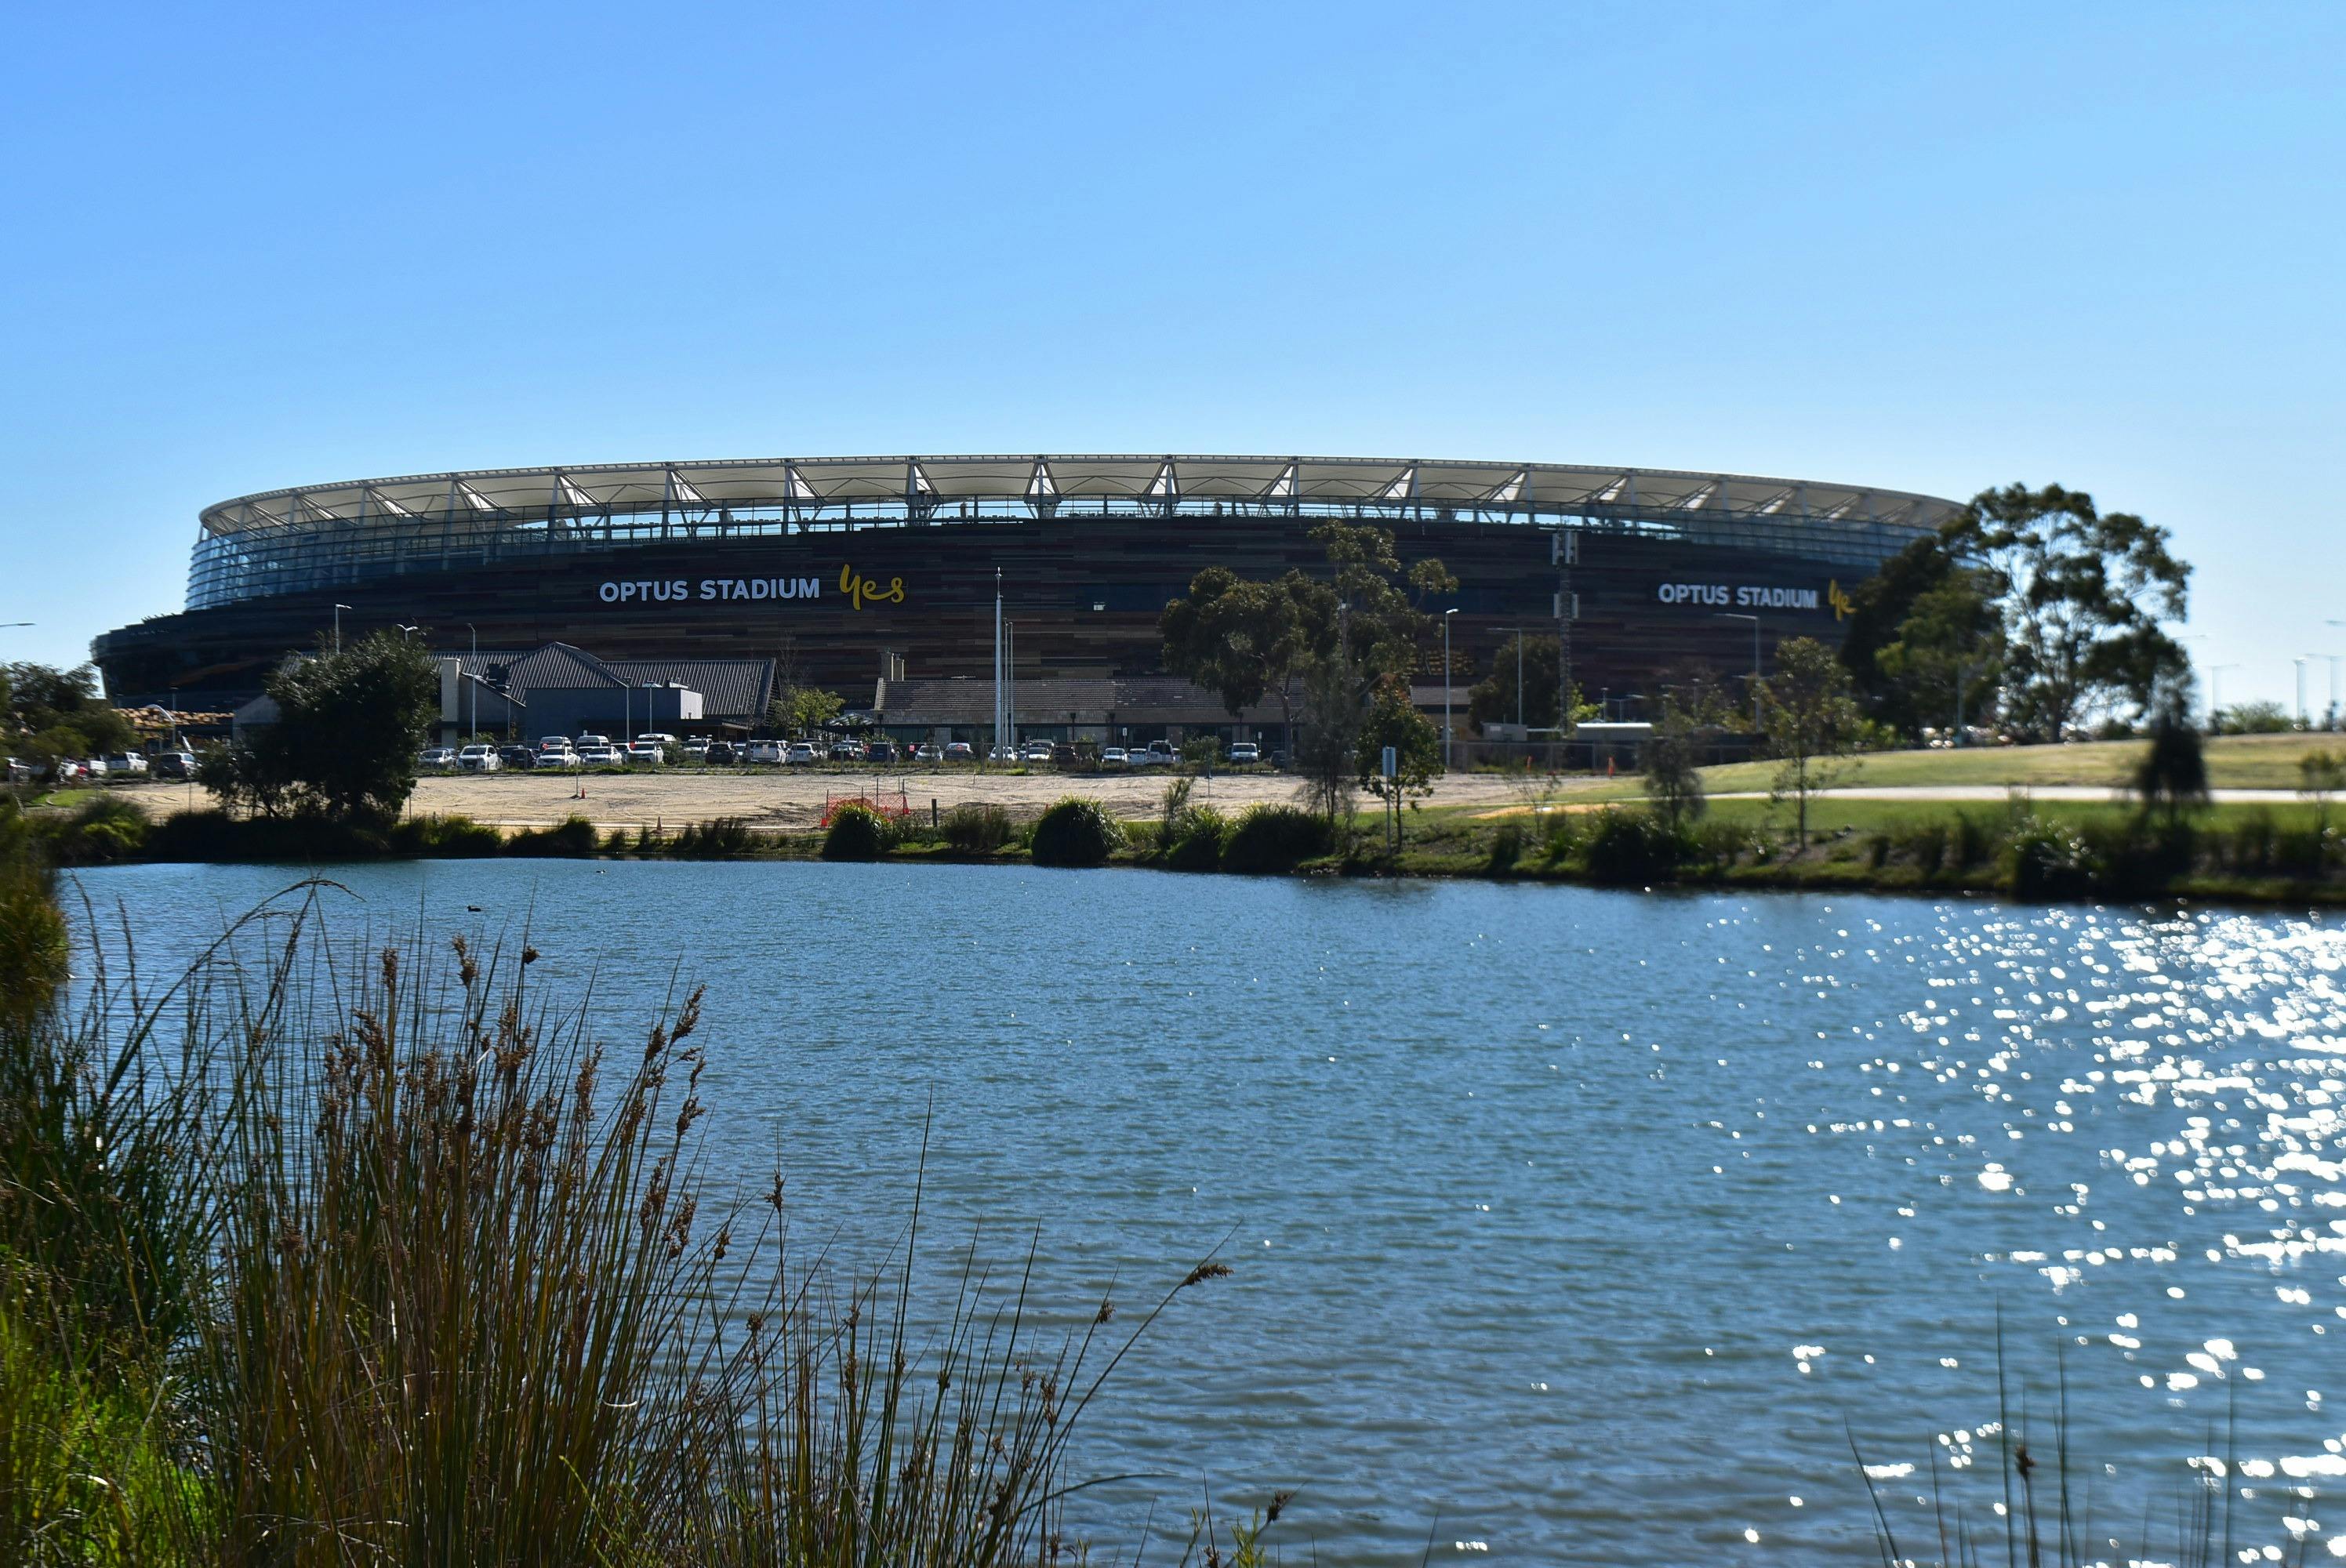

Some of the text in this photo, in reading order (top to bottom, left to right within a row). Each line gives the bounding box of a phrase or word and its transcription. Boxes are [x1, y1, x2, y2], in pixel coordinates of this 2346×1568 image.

[599, 581, 688, 602] OPTUS
[699, 578, 820, 600] STADIUM
[1658, 583, 1729, 604] OPTUS
[1736, 587, 1818, 608] STADIUM
